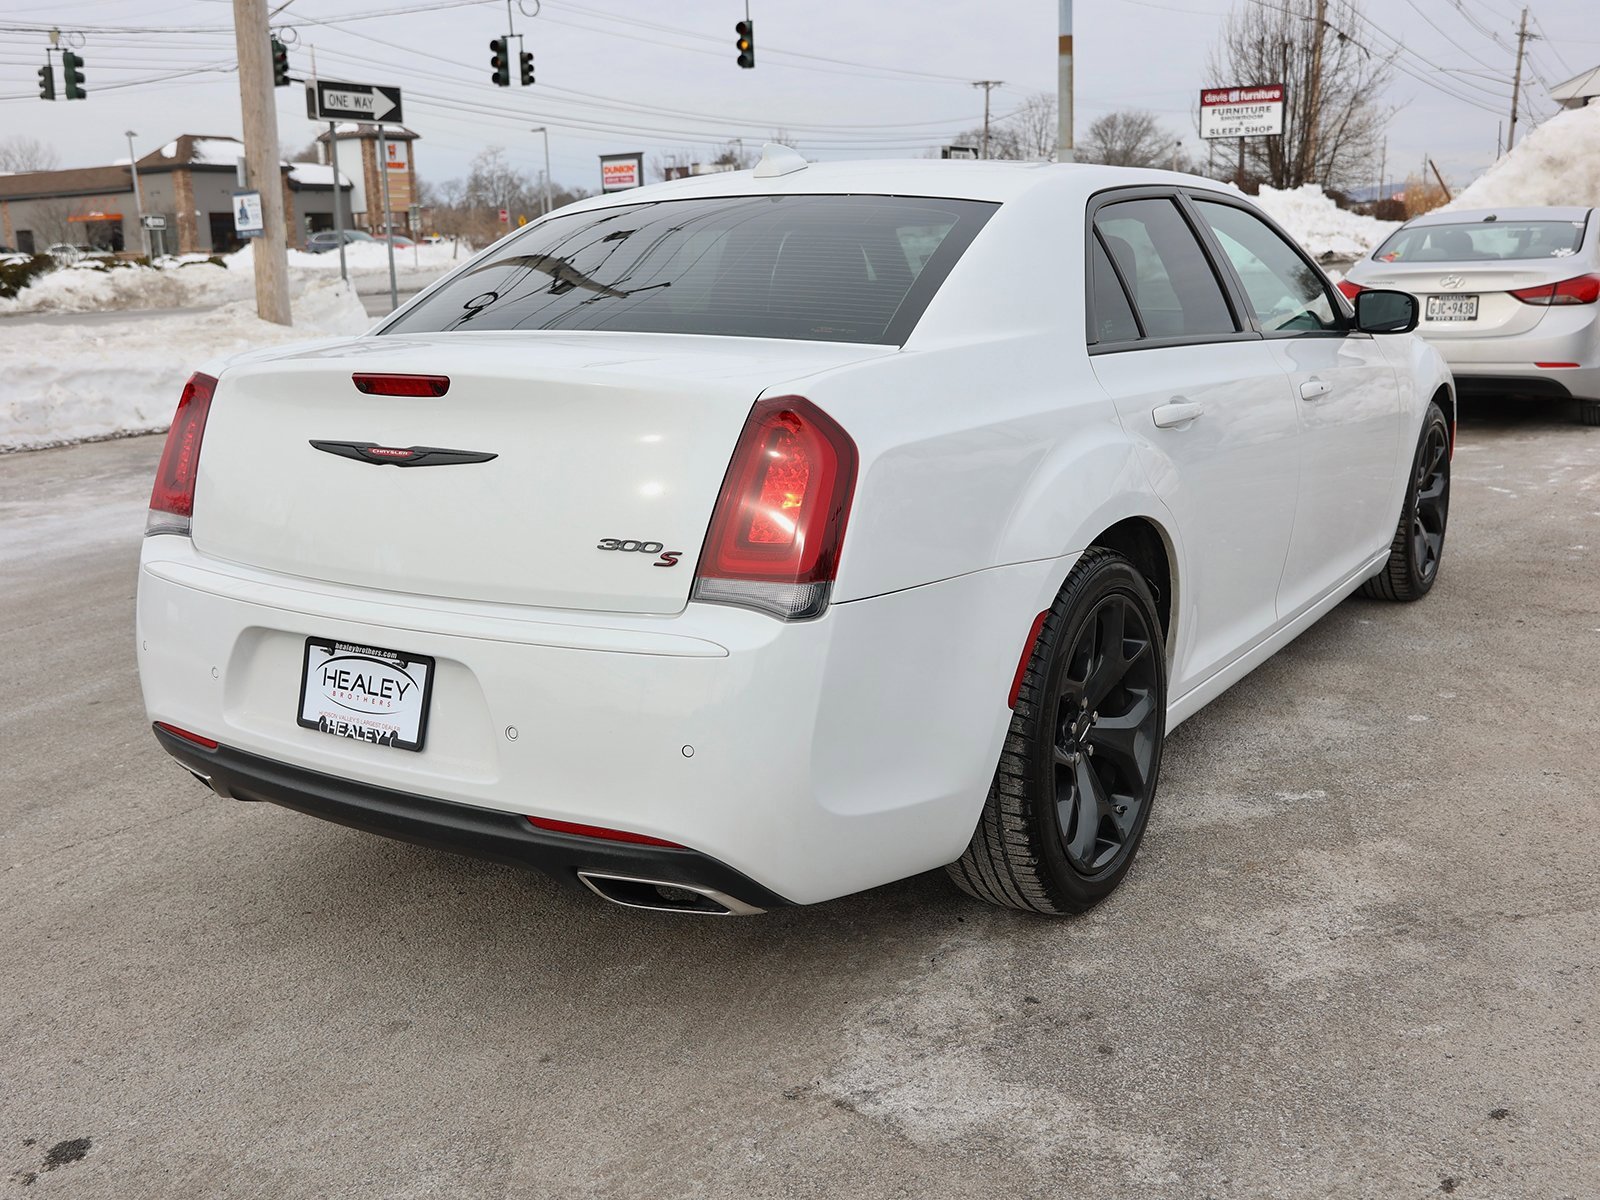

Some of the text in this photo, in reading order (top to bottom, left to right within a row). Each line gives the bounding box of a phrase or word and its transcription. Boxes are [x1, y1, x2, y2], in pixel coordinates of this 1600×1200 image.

[329, 94, 374, 110] ONE WAY
[1204, 93, 1228, 103] davis
[1240, 89, 1281, 101] furniture
[1212, 105, 1272, 116] FURNITURE
[1209, 125, 1273, 136] SLEEP SHOP
[597, 538, 683, 567] 300 S
[335, 642, 398, 659] healeybrothers.com
[322, 667, 410, 701] HEALEY
[332, 690, 392, 708] BROTHERS
[326, 719, 387, 744] HEALEY
[360, 719, 381, 728] LARGEST
[381, 723, 400, 731] DEALER
